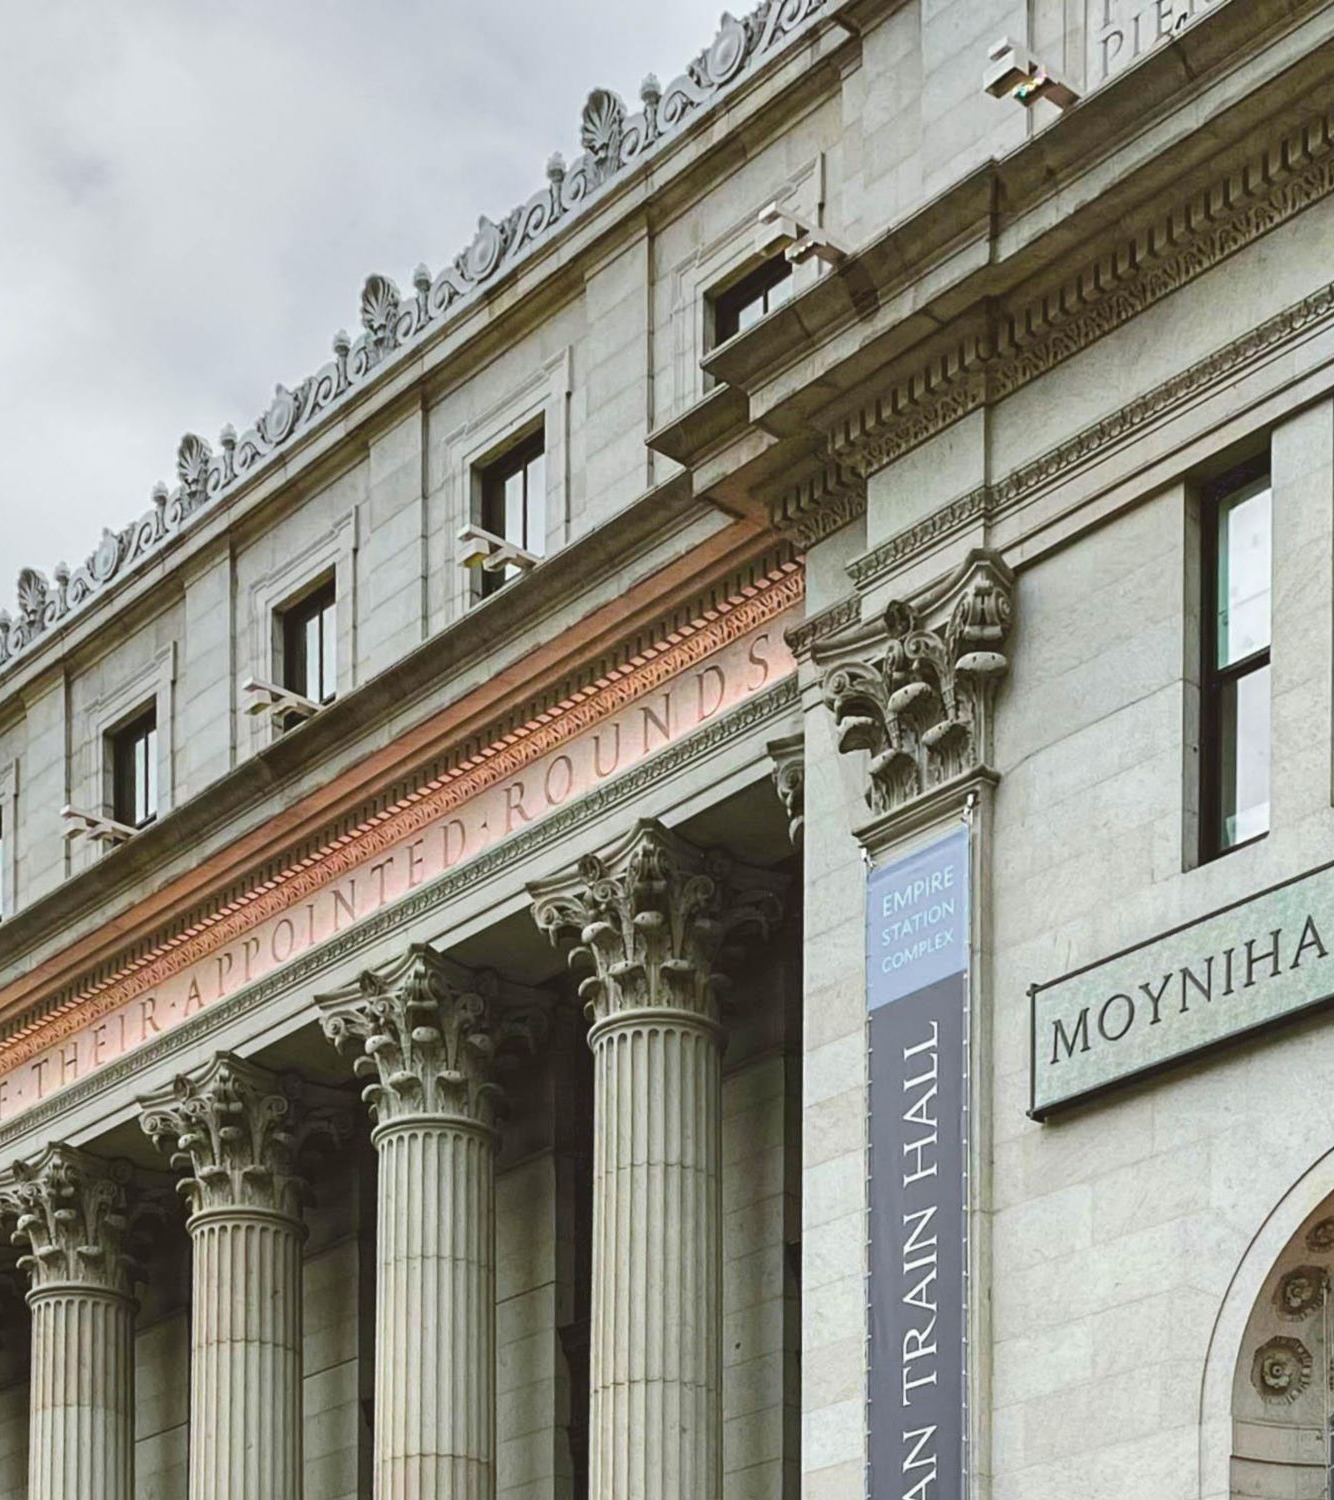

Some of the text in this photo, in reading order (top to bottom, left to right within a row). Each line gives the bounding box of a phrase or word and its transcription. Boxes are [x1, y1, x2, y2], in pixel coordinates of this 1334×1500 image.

[31, 997, 162, 1099] THEIR
[183, 818, 467, 1018] APPOINTED
[504, 633, 771, 835] ROUNDS
[881, 865, 955, 917] EMPIRE
[881, 898, 955, 946] STATION
[881, 927, 954, 973] COMPLEX
[903, 1020, 938, 1186] HALL
[903, 1212, 938, 1406] TRAIN
